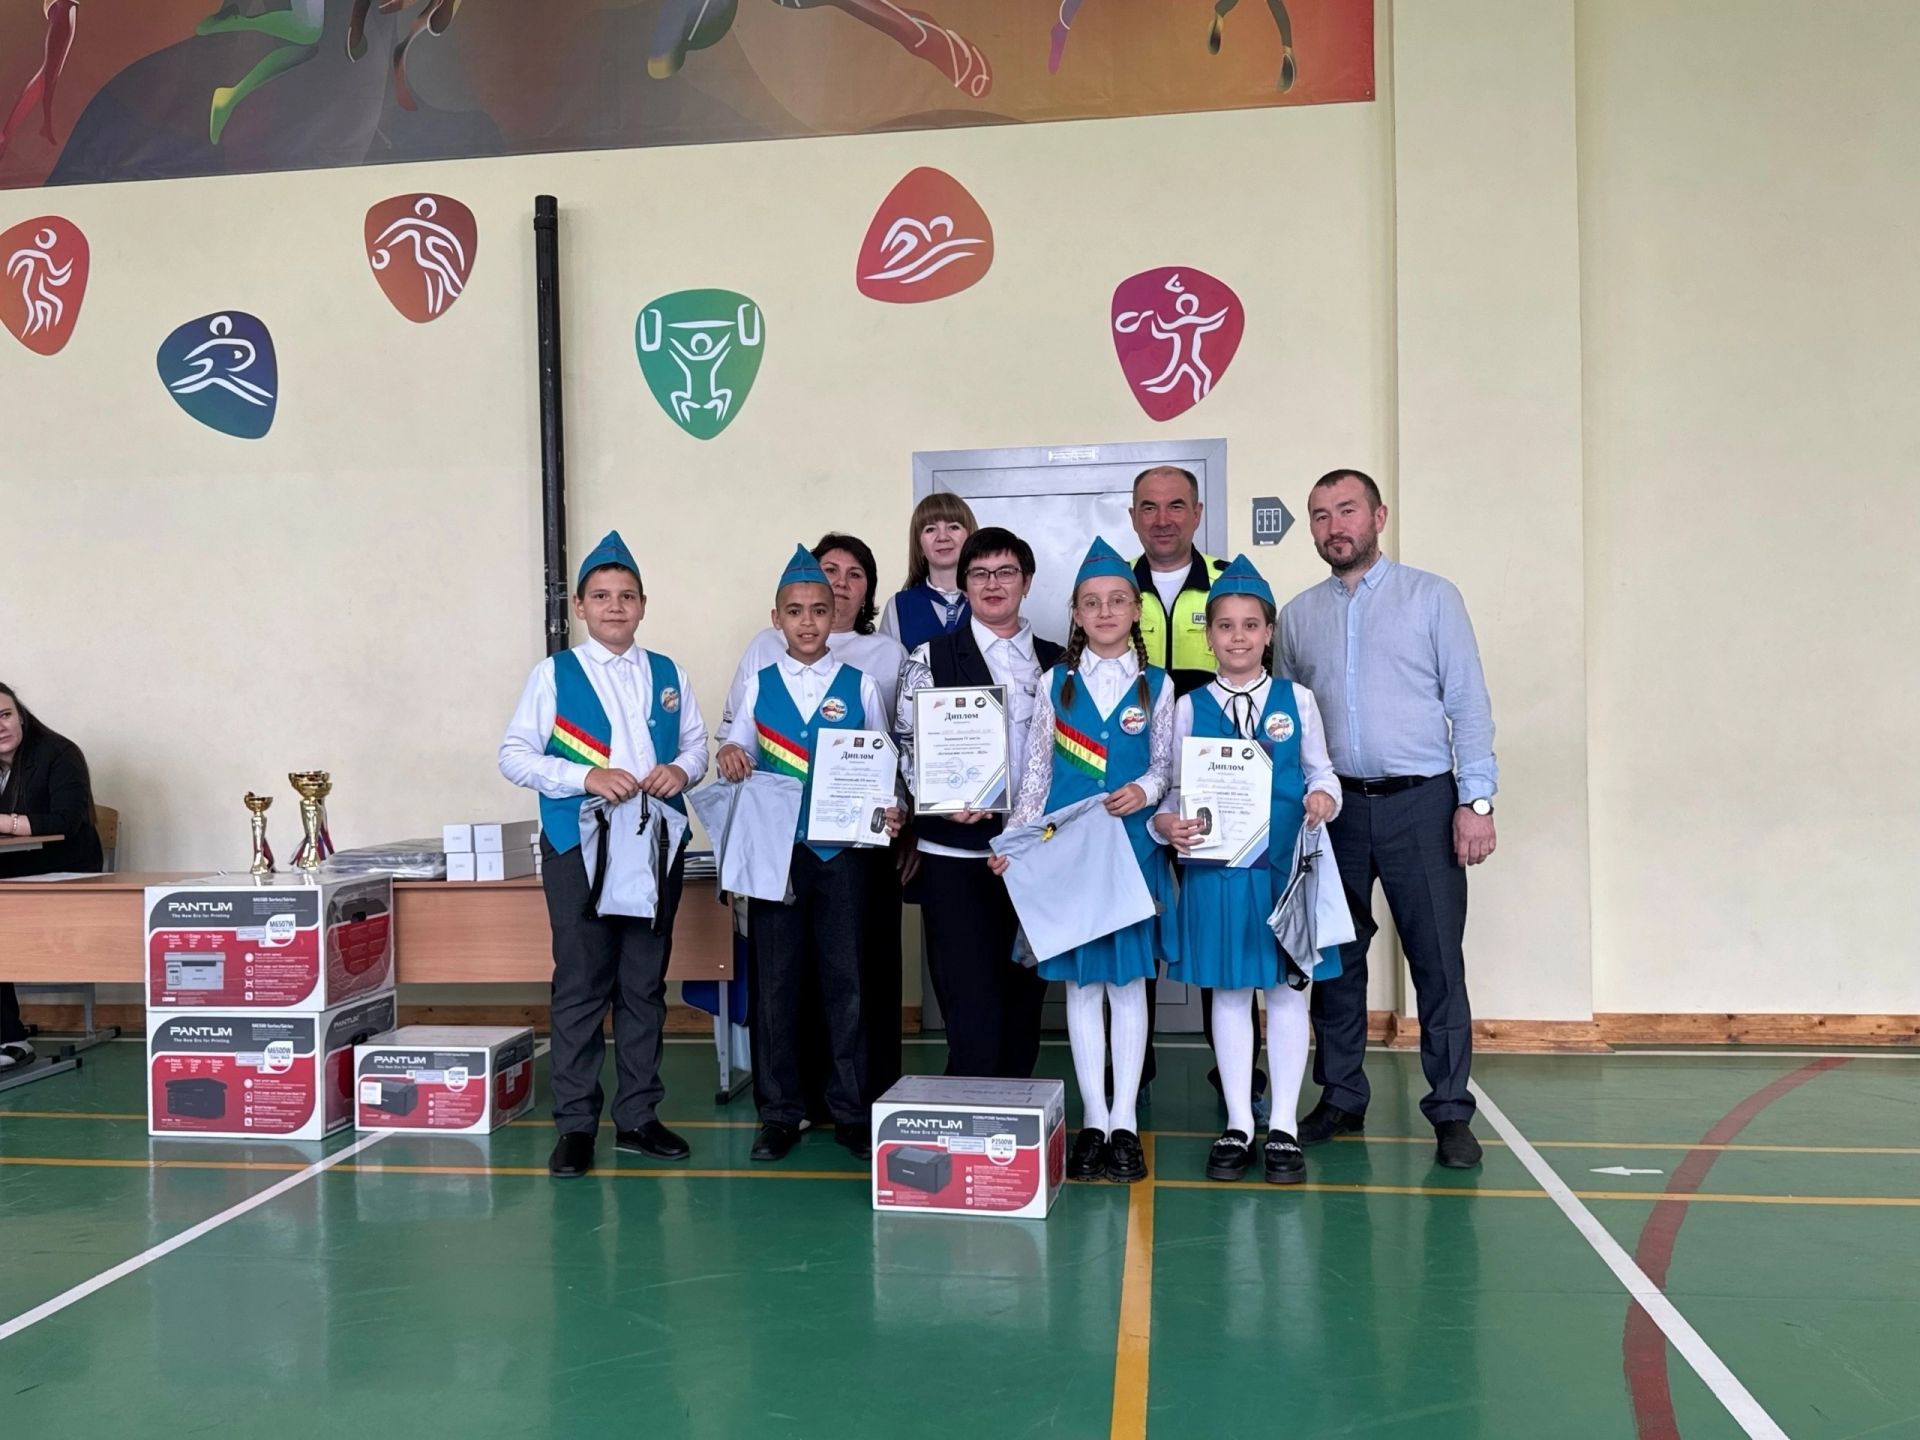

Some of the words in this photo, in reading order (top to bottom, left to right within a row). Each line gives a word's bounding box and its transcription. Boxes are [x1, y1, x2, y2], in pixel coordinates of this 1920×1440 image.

[944, 712, 979, 721] Диплом
[841, 751, 874, 760] Диплом
[1208, 762, 1244, 771] Диплом
[168, 902, 233, 912] PANTUM
[170, 1026, 233, 1036] PANTUM
[373, 1055, 427, 1064] PANTUM
[896, 1118, 963, 1129] PANTUM
